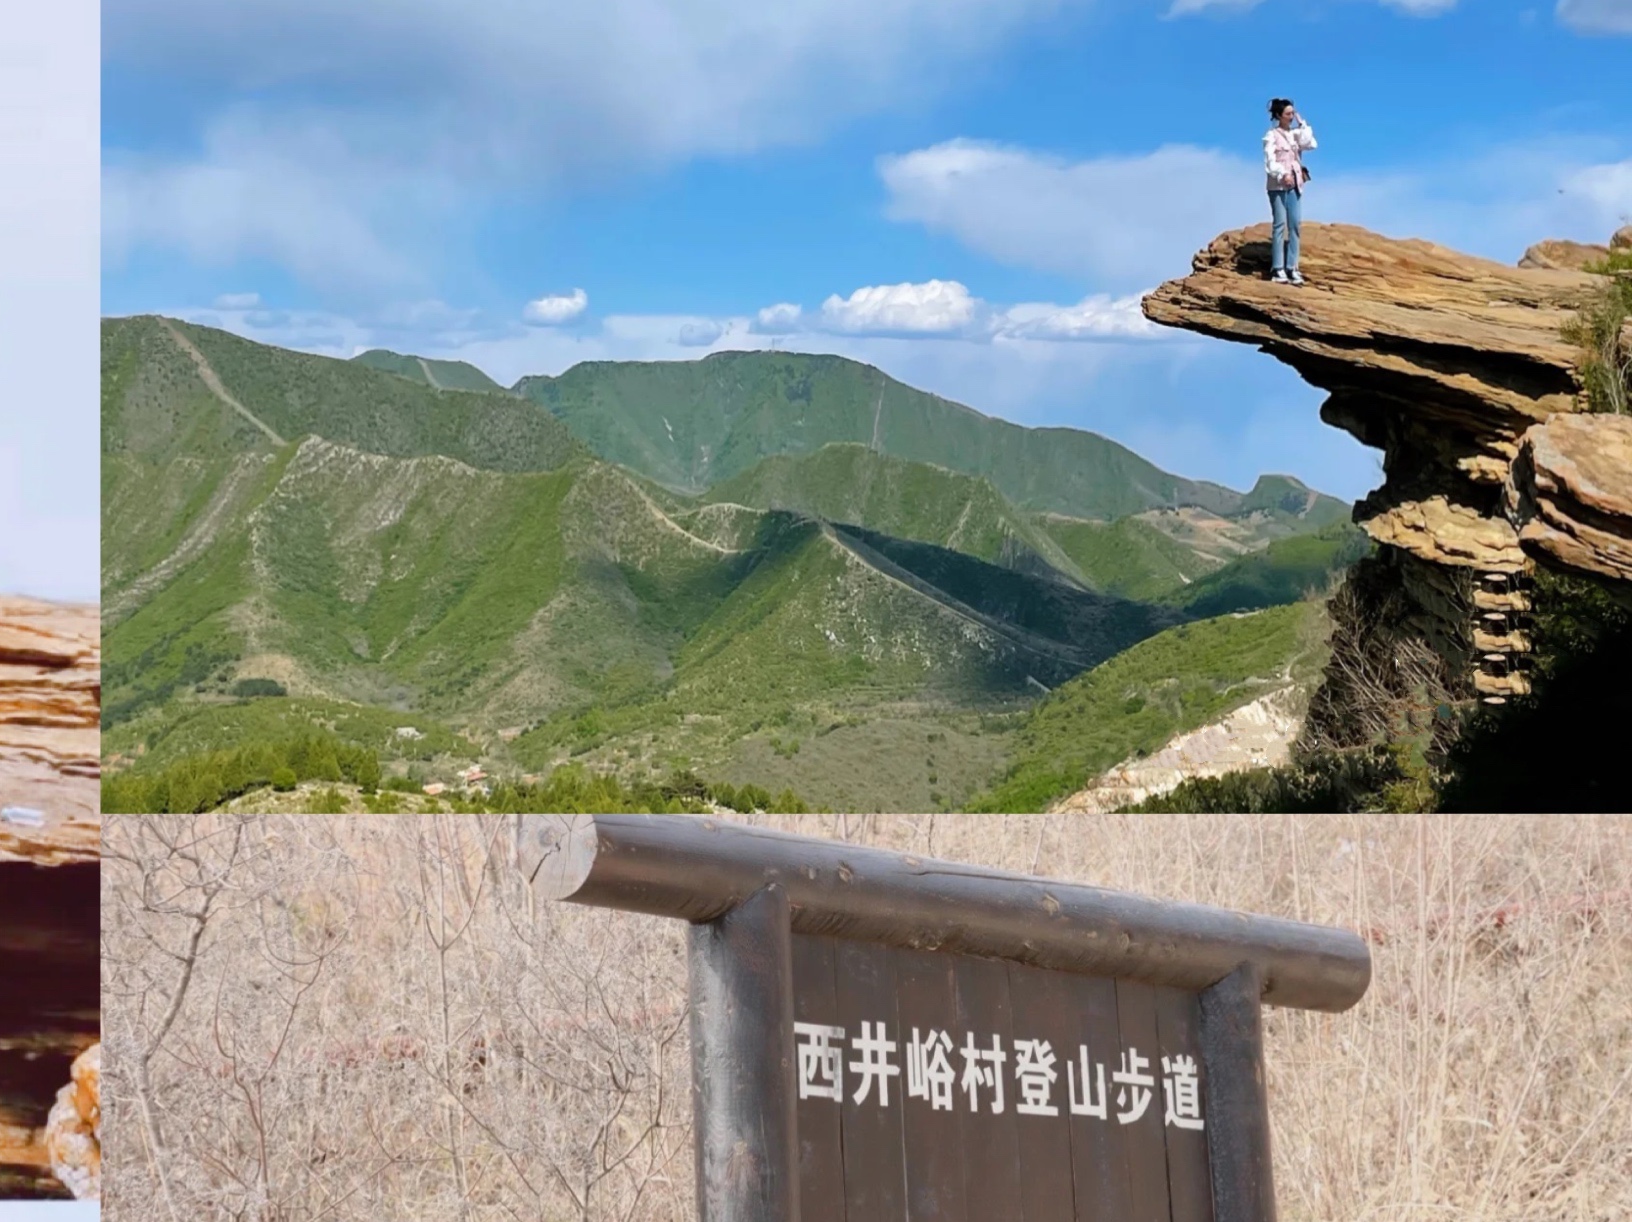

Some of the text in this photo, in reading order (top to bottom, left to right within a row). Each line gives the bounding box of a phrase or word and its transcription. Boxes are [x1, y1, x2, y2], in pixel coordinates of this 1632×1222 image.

[794, 1020, 1205, 1131] 西井峪村登山步道
